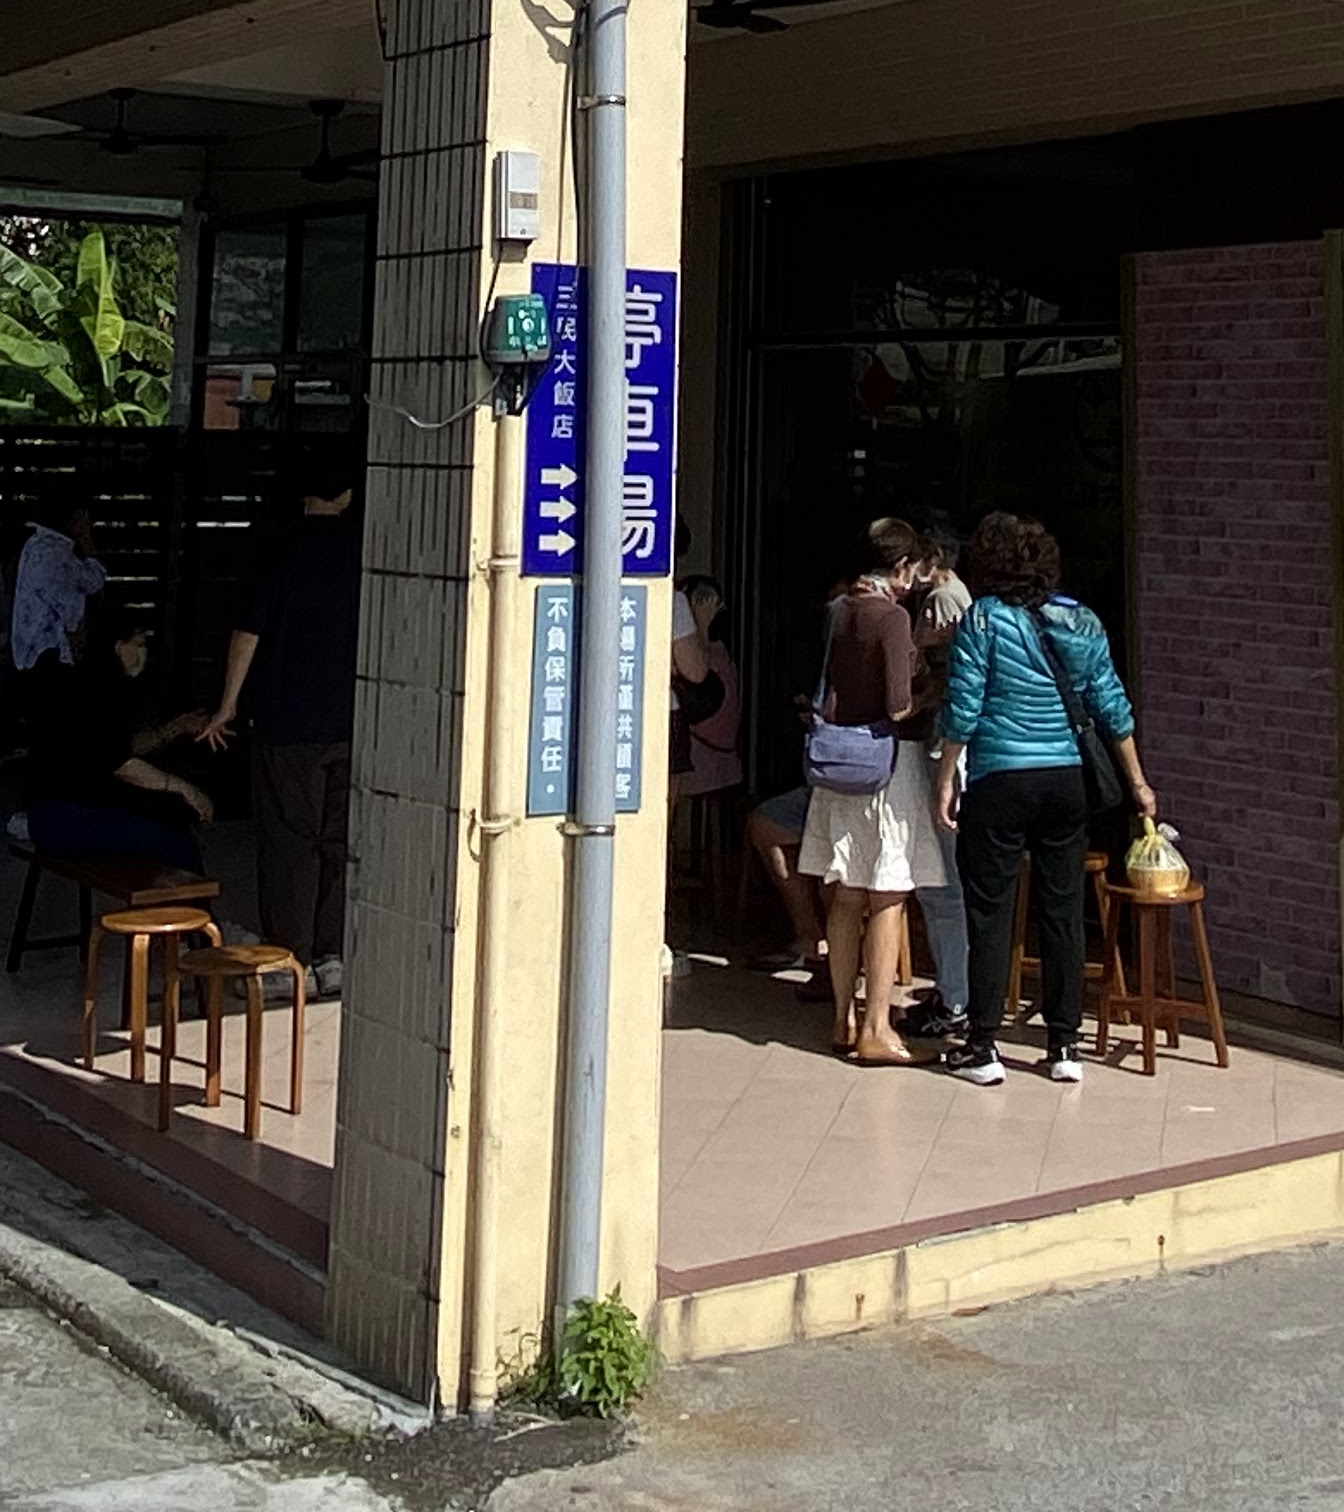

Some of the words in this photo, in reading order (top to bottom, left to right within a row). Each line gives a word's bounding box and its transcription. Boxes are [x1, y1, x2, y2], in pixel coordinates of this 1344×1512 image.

[550, 284, 578, 439] 三民大飯店
